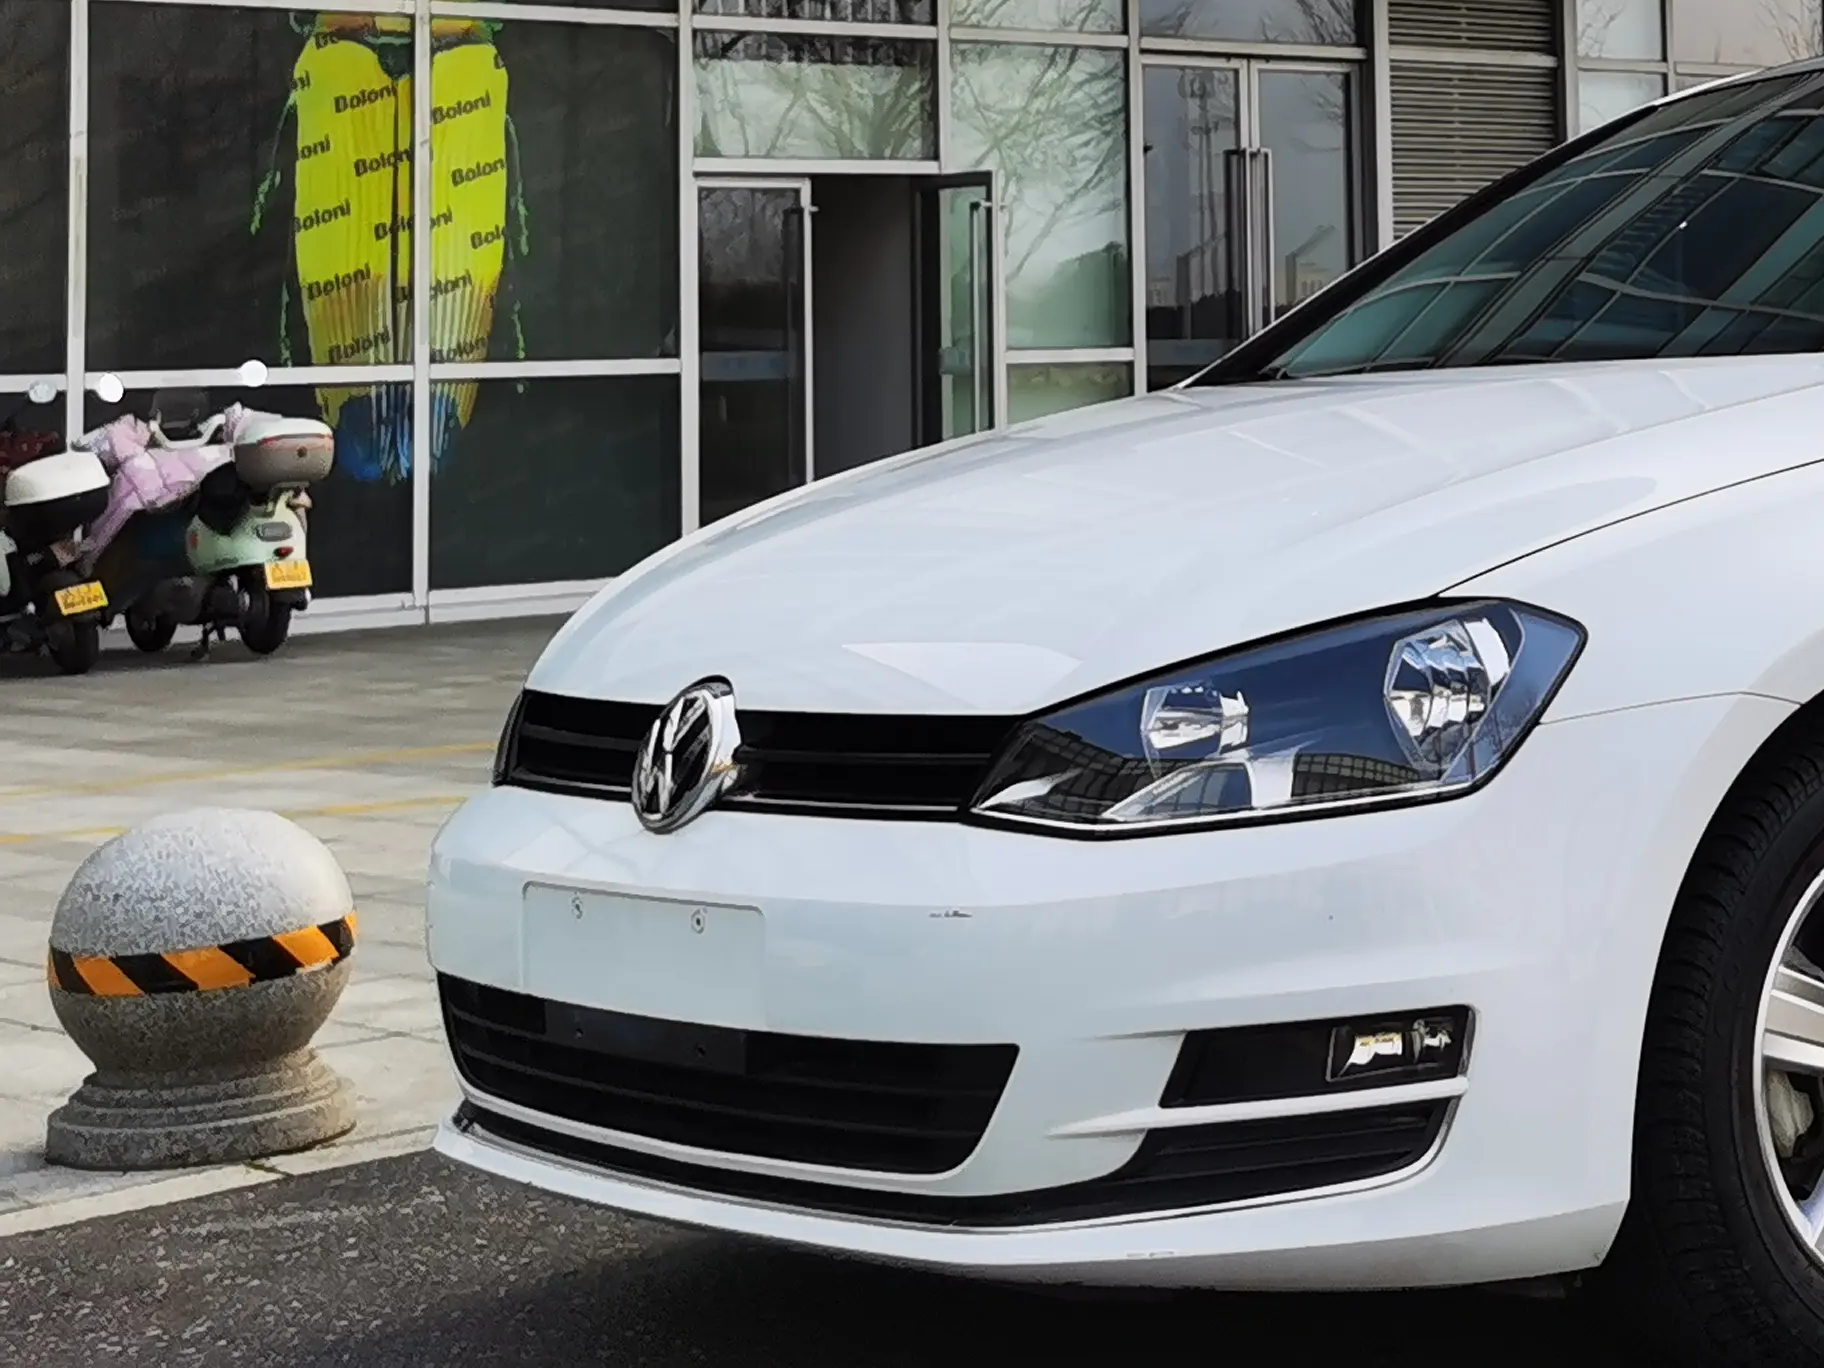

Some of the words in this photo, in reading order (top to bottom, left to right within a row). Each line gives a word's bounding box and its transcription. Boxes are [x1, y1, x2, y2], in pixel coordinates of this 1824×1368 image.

[431, 89, 491, 125] Boloni
[299, 133, 331, 160] oni
[353, 147, 412, 178] Bolon
[451, 157, 505, 187] Bolon
[307, 262, 371, 301] Boloni
